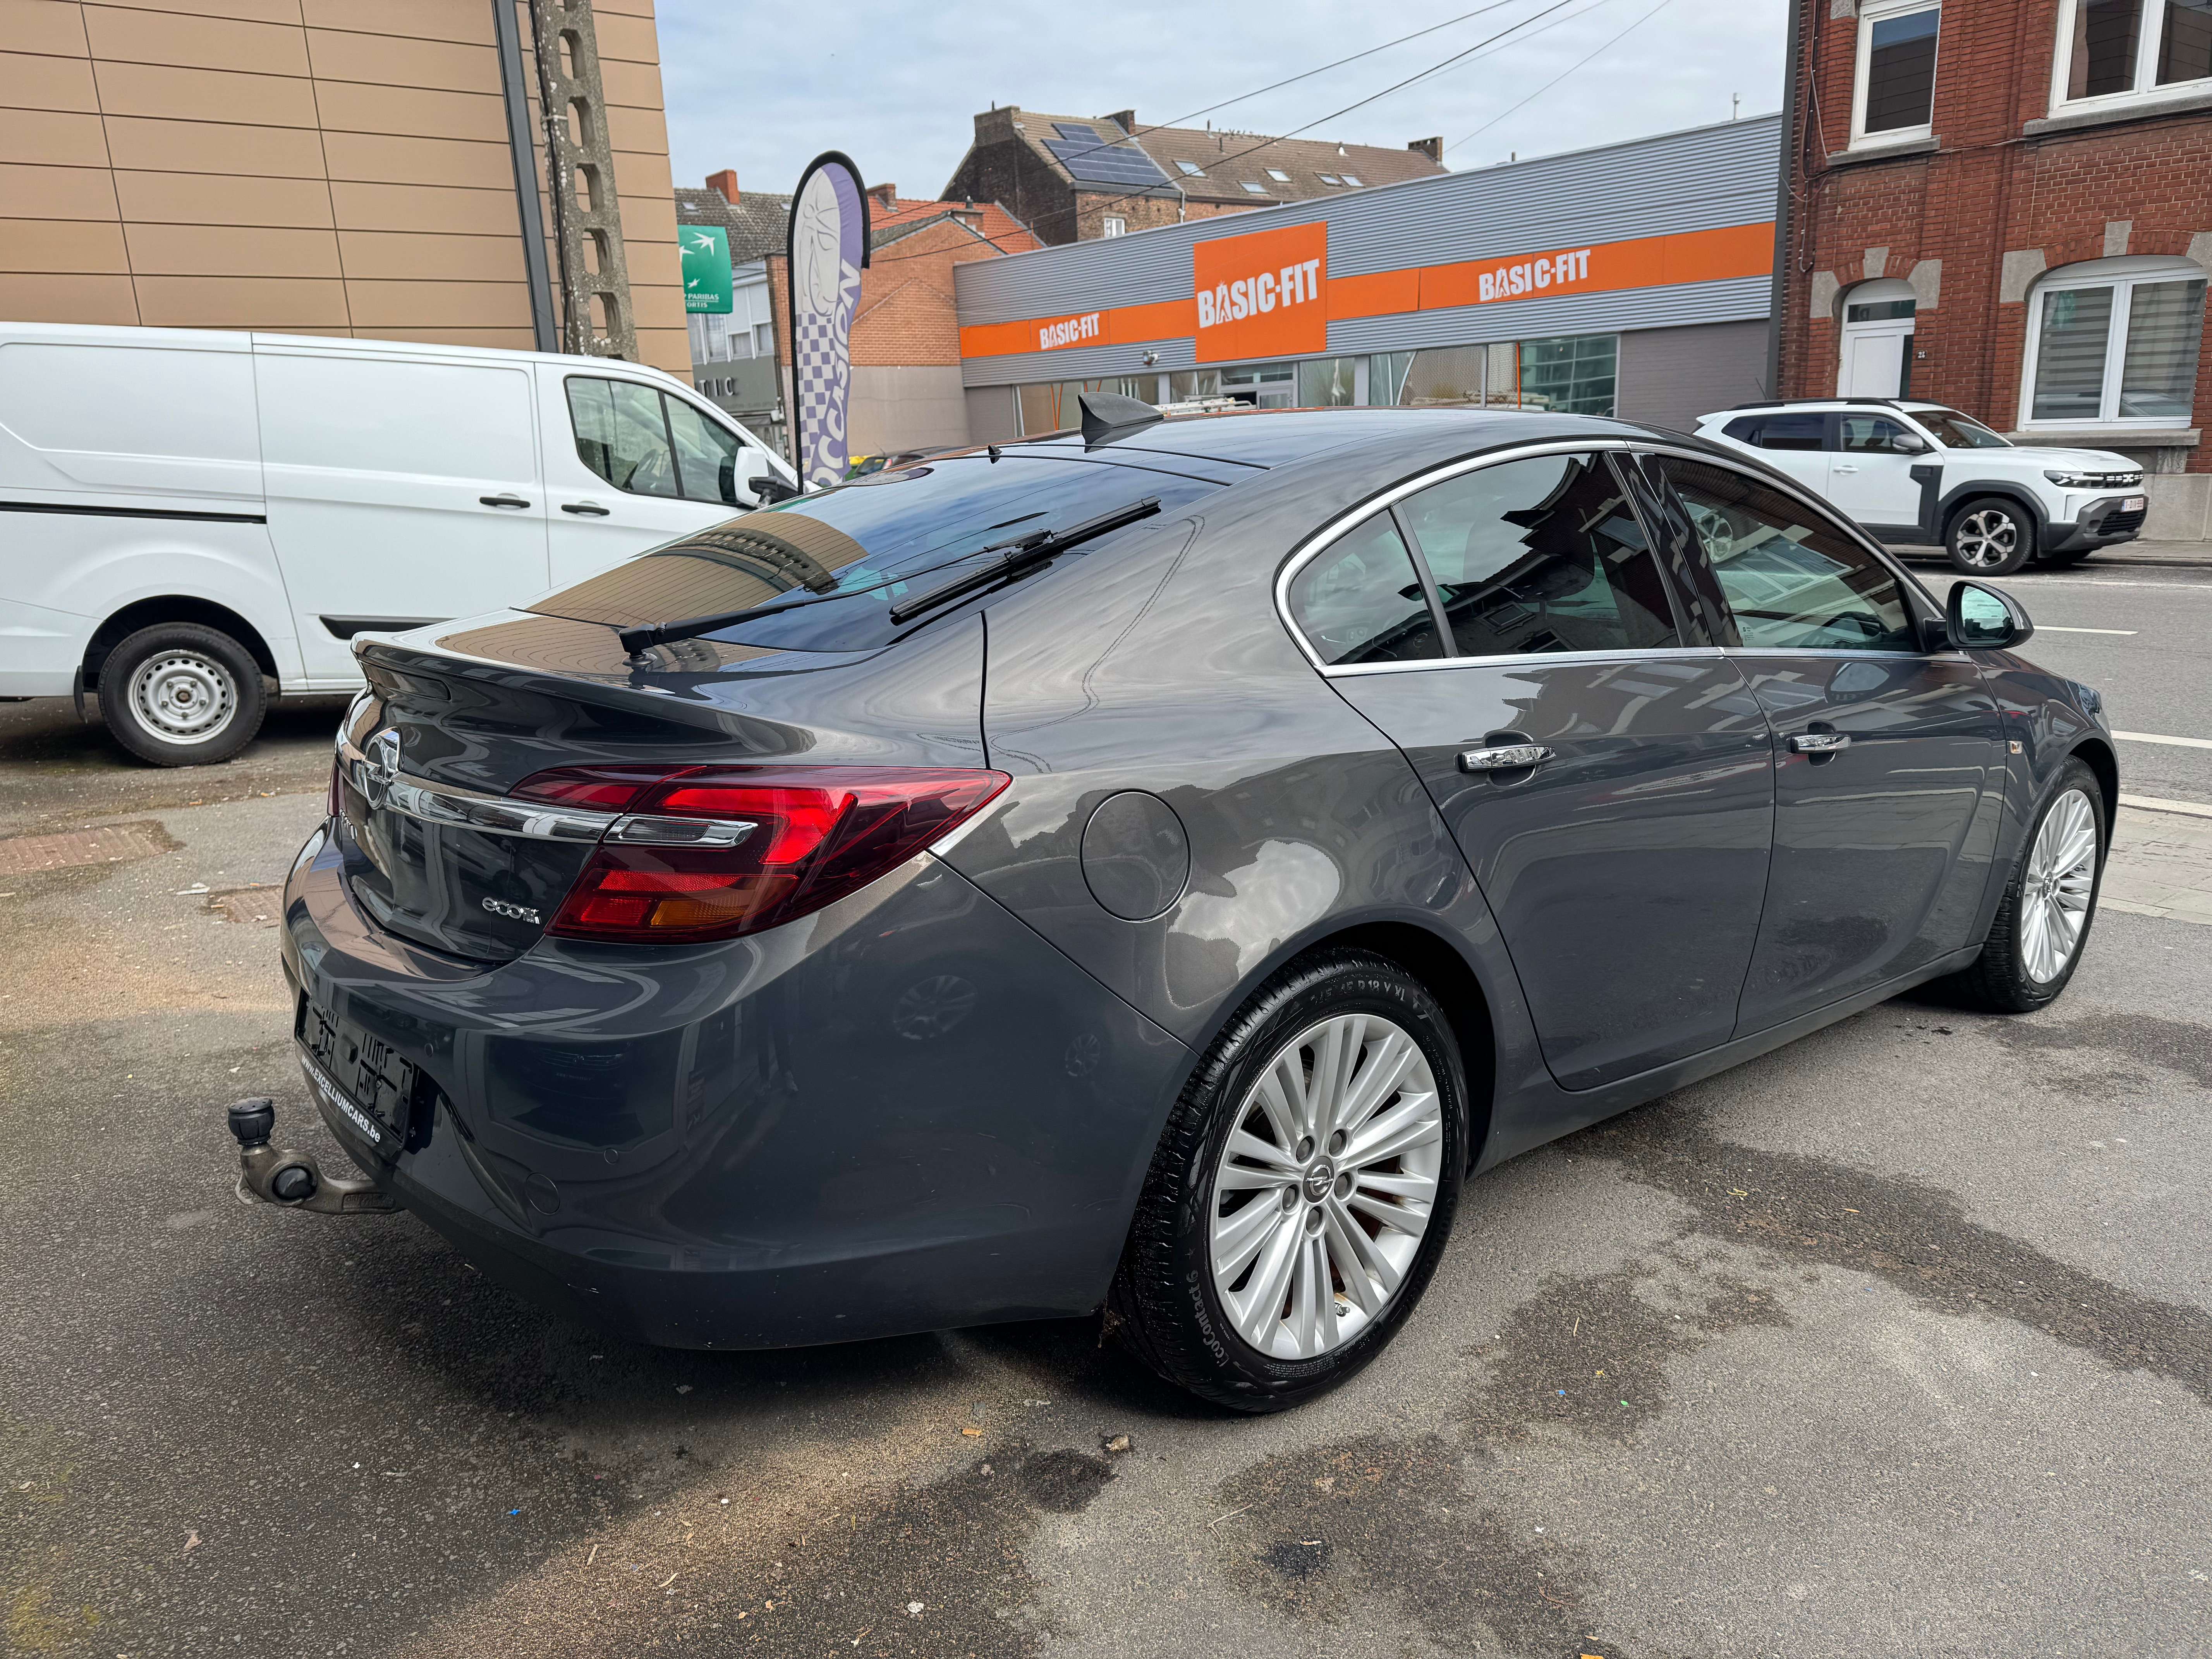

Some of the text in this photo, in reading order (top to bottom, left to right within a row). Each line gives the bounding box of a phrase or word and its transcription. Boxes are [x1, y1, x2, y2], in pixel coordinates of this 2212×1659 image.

[1197, 258, 1320, 329] BASIC-FIT
[1479, 249, 1591, 302] BASIC-FIT
[1039, 312, 1100, 350] BASIC-FIT
[1186, 1270, 1199, 1283] 6
